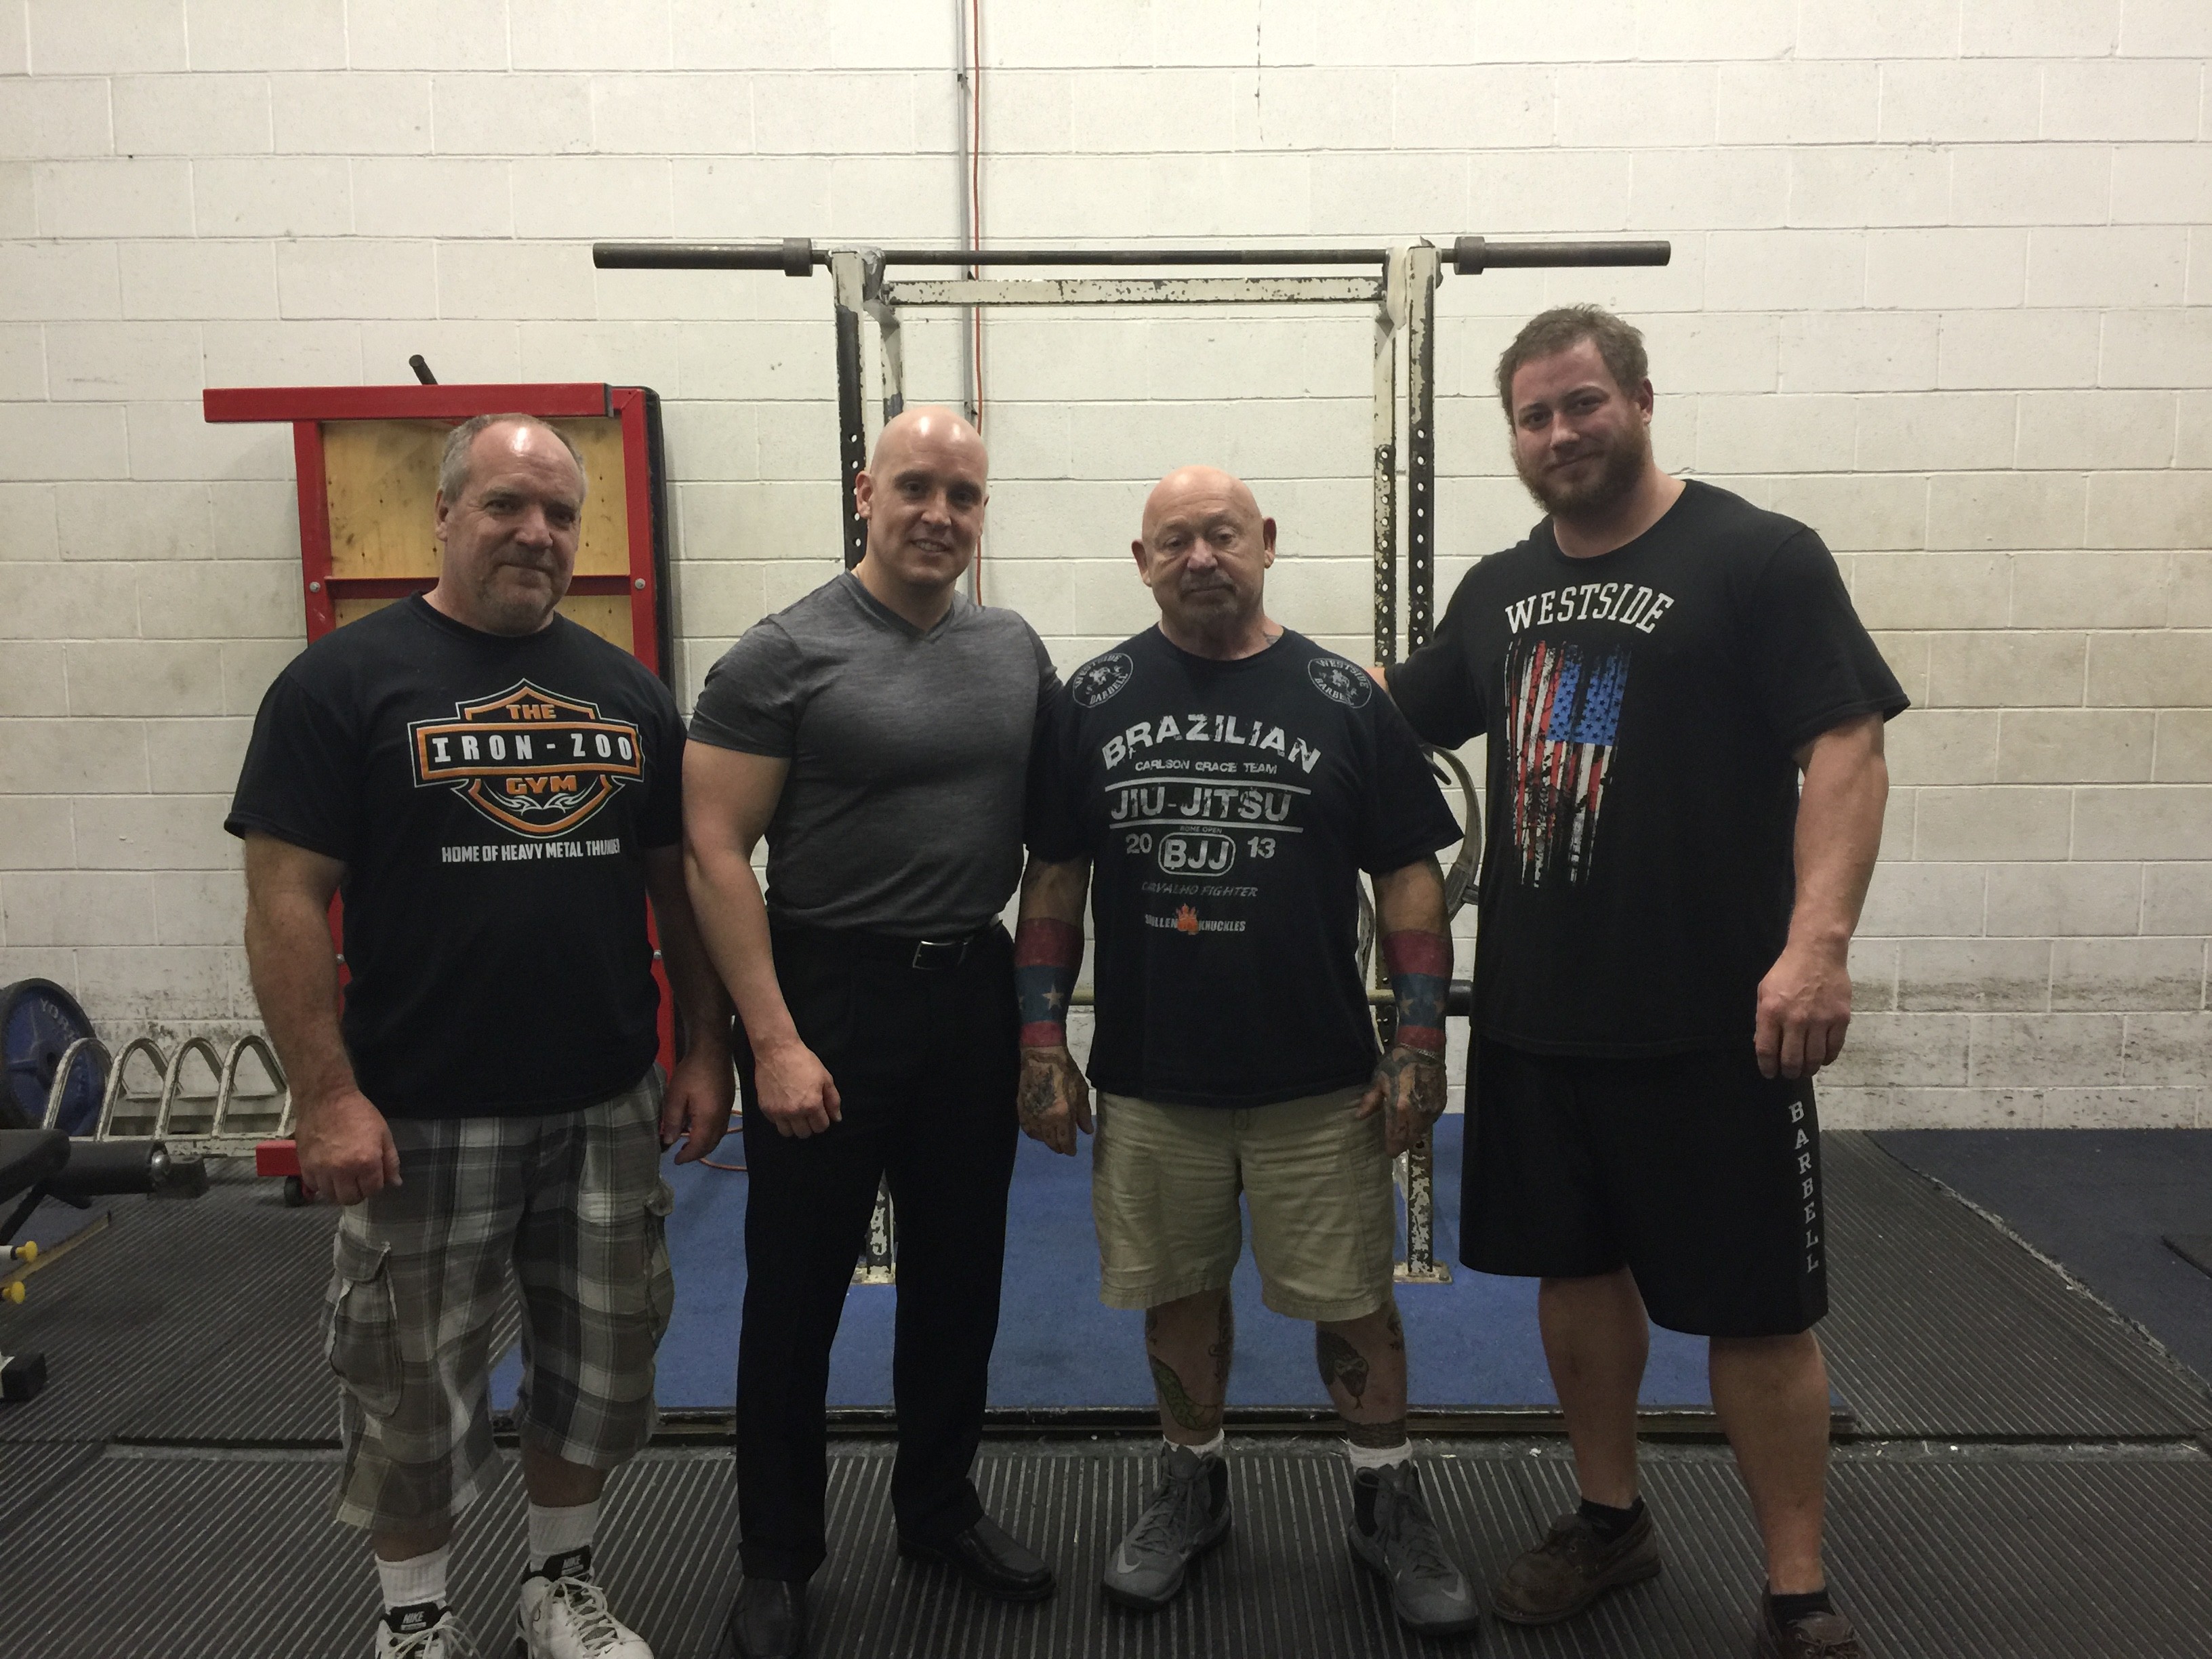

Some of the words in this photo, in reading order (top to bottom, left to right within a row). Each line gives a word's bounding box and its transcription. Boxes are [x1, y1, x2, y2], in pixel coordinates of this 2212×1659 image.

[1505, 582, 1675, 634] WESTSIDE
[1074, 655, 1122, 689] WESTIDE
[1315, 659, 1369, 689] WESTSIDE
[1089, 673, 1128, 705] BARBELL
[506, 704, 556, 720] THE
[1102, 714, 1321, 774] BRAZILIAN
[1134, 759, 1190, 772] CARLSON
[1243, 762, 1277, 775] TEAM
[506, 775, 577, 795] GYM
[1111, 786, 1292, 821] JIU-JITSU
[1202, 825, 1223, 834] OPEN
[441, 845, 480, 863] HOME
[482, 845, 499, 861] OF
[501, 843, 543, 861] HEAVY
[545, 841, 584, 859] METAL
[1125, 833, 1153, 855] 20
[1163, 839, 1229, 870] BJJ
[1247, 836, 1277, 859] 13
[1200, 885, 1258, 897] FIGHTER
[1198, 920, 1246, 932] KNUCKLES
[1788, 1101, 1820, 1273] BARBELL
[562, 1555, 581, 1569] NIKE
[403, 1611, 425, 1624] NIKE
